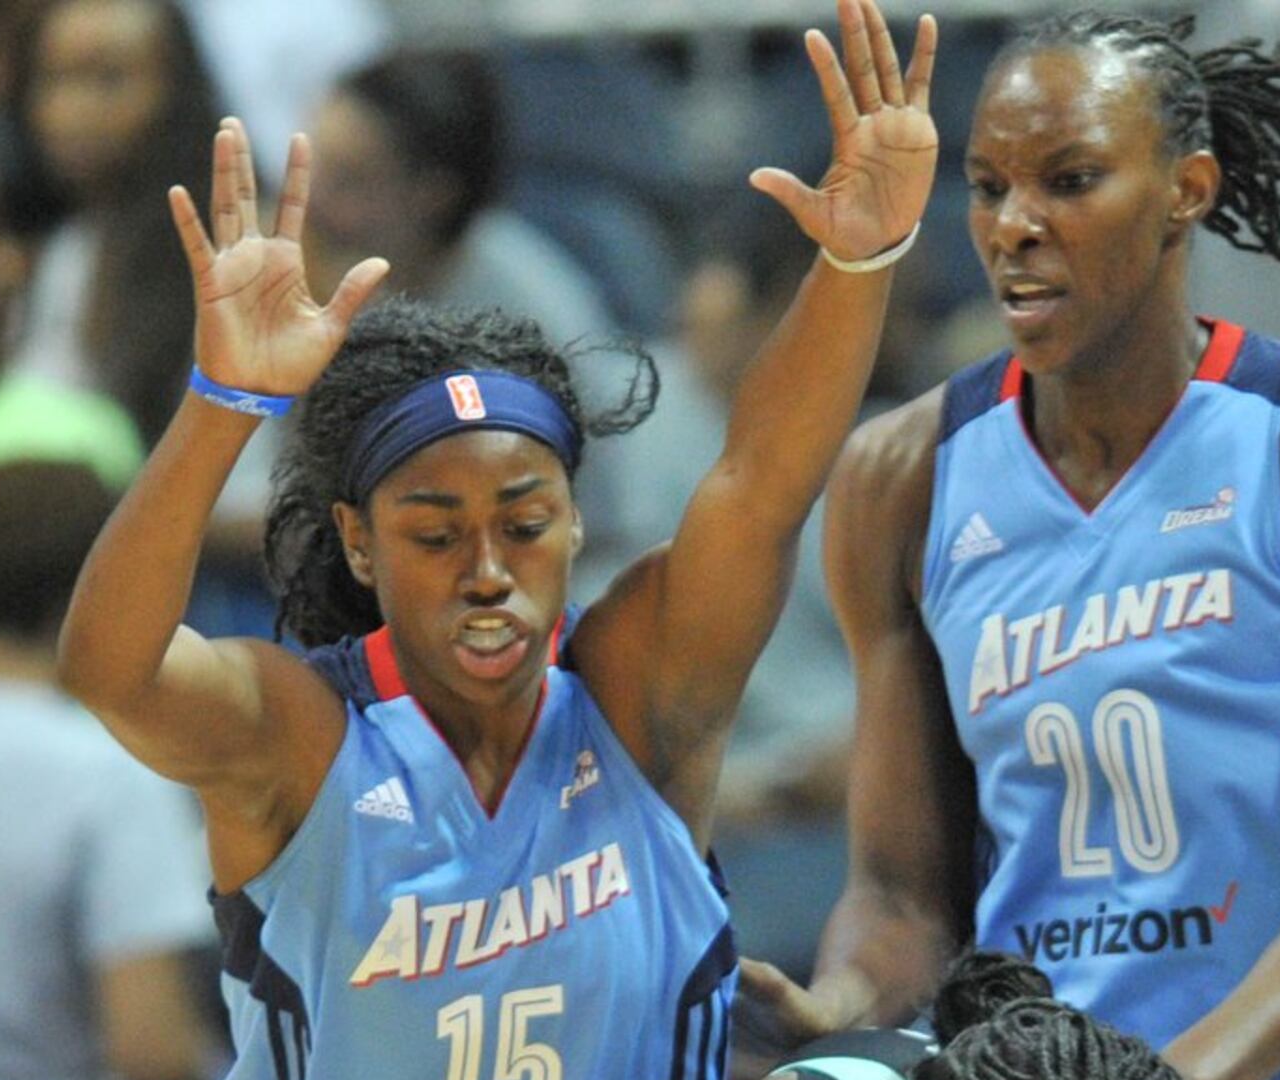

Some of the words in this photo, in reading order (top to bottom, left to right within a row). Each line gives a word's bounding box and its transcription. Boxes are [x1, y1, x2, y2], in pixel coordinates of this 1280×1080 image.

[968, 569, 1234, 714] ATLANTA
[1025, 688, 1181, 878] 20
[349, 842, 631, 987] ATLANTA
[1013, 902, 1213, 962] verizon
